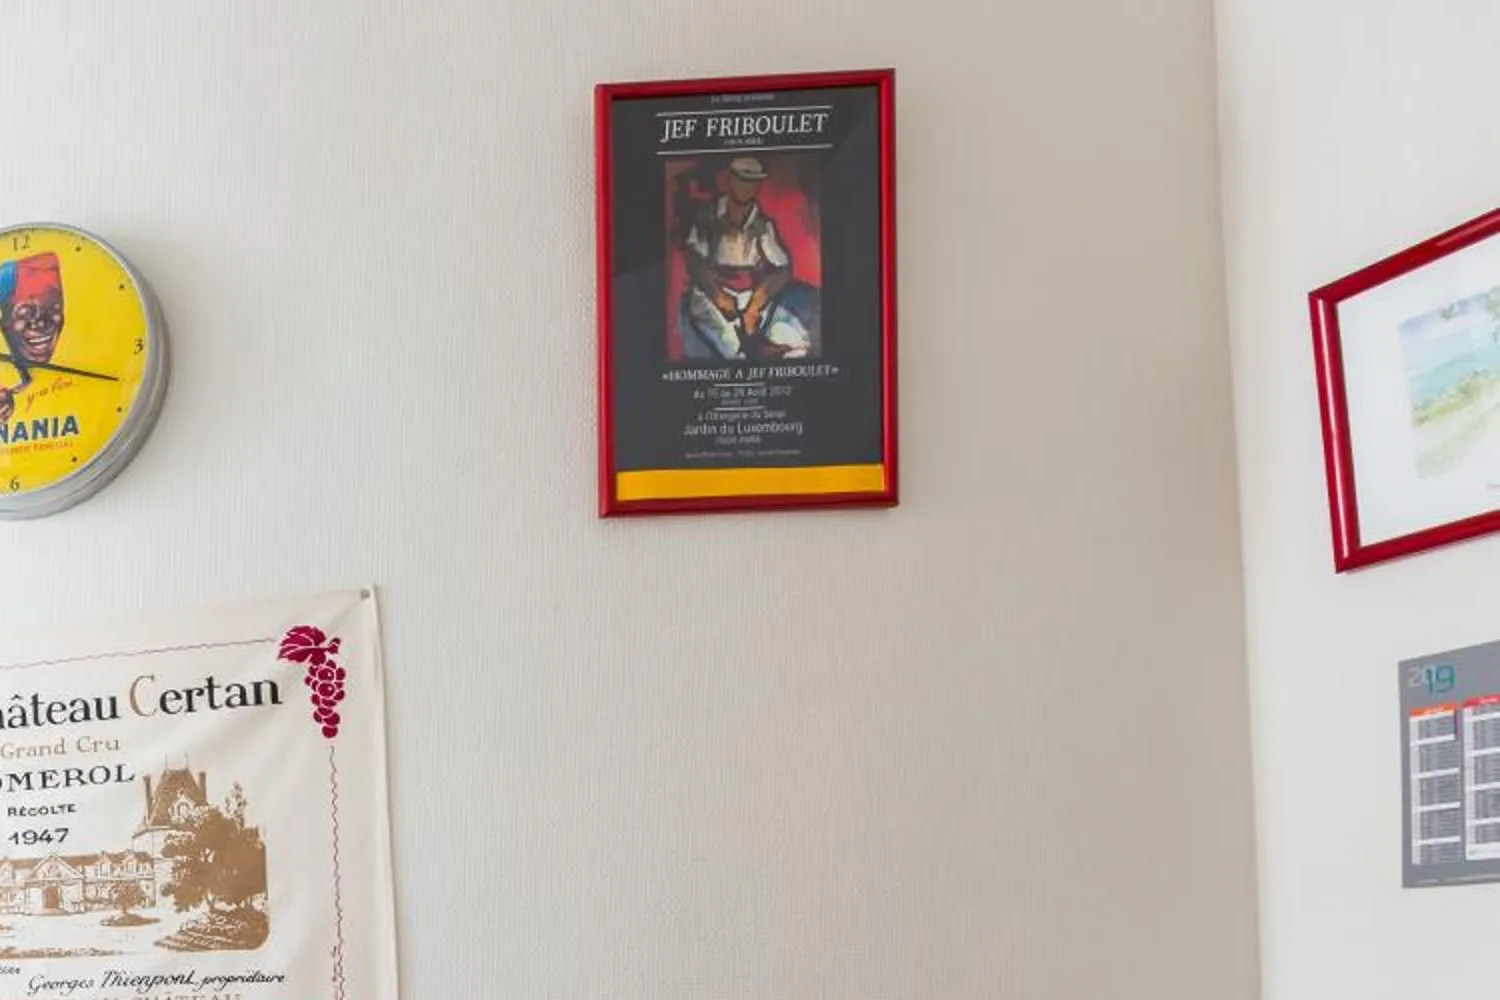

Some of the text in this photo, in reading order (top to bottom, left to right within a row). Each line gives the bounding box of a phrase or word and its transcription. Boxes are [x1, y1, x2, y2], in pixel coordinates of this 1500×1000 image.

[660, 113, 829, 143] JEF FRIBOULET
[11, 236, 31, 251] 12
[133, 338, 144, 355] 3
[9, 476, 21, 492] 6
[129, 674, 283, 717] Certan
[0, 737, 67, 759] Grand
[77, 735, 121, 753] Cru
[8, 827, 69, 846] 1947
[28, 974, 95, 996] Georges
